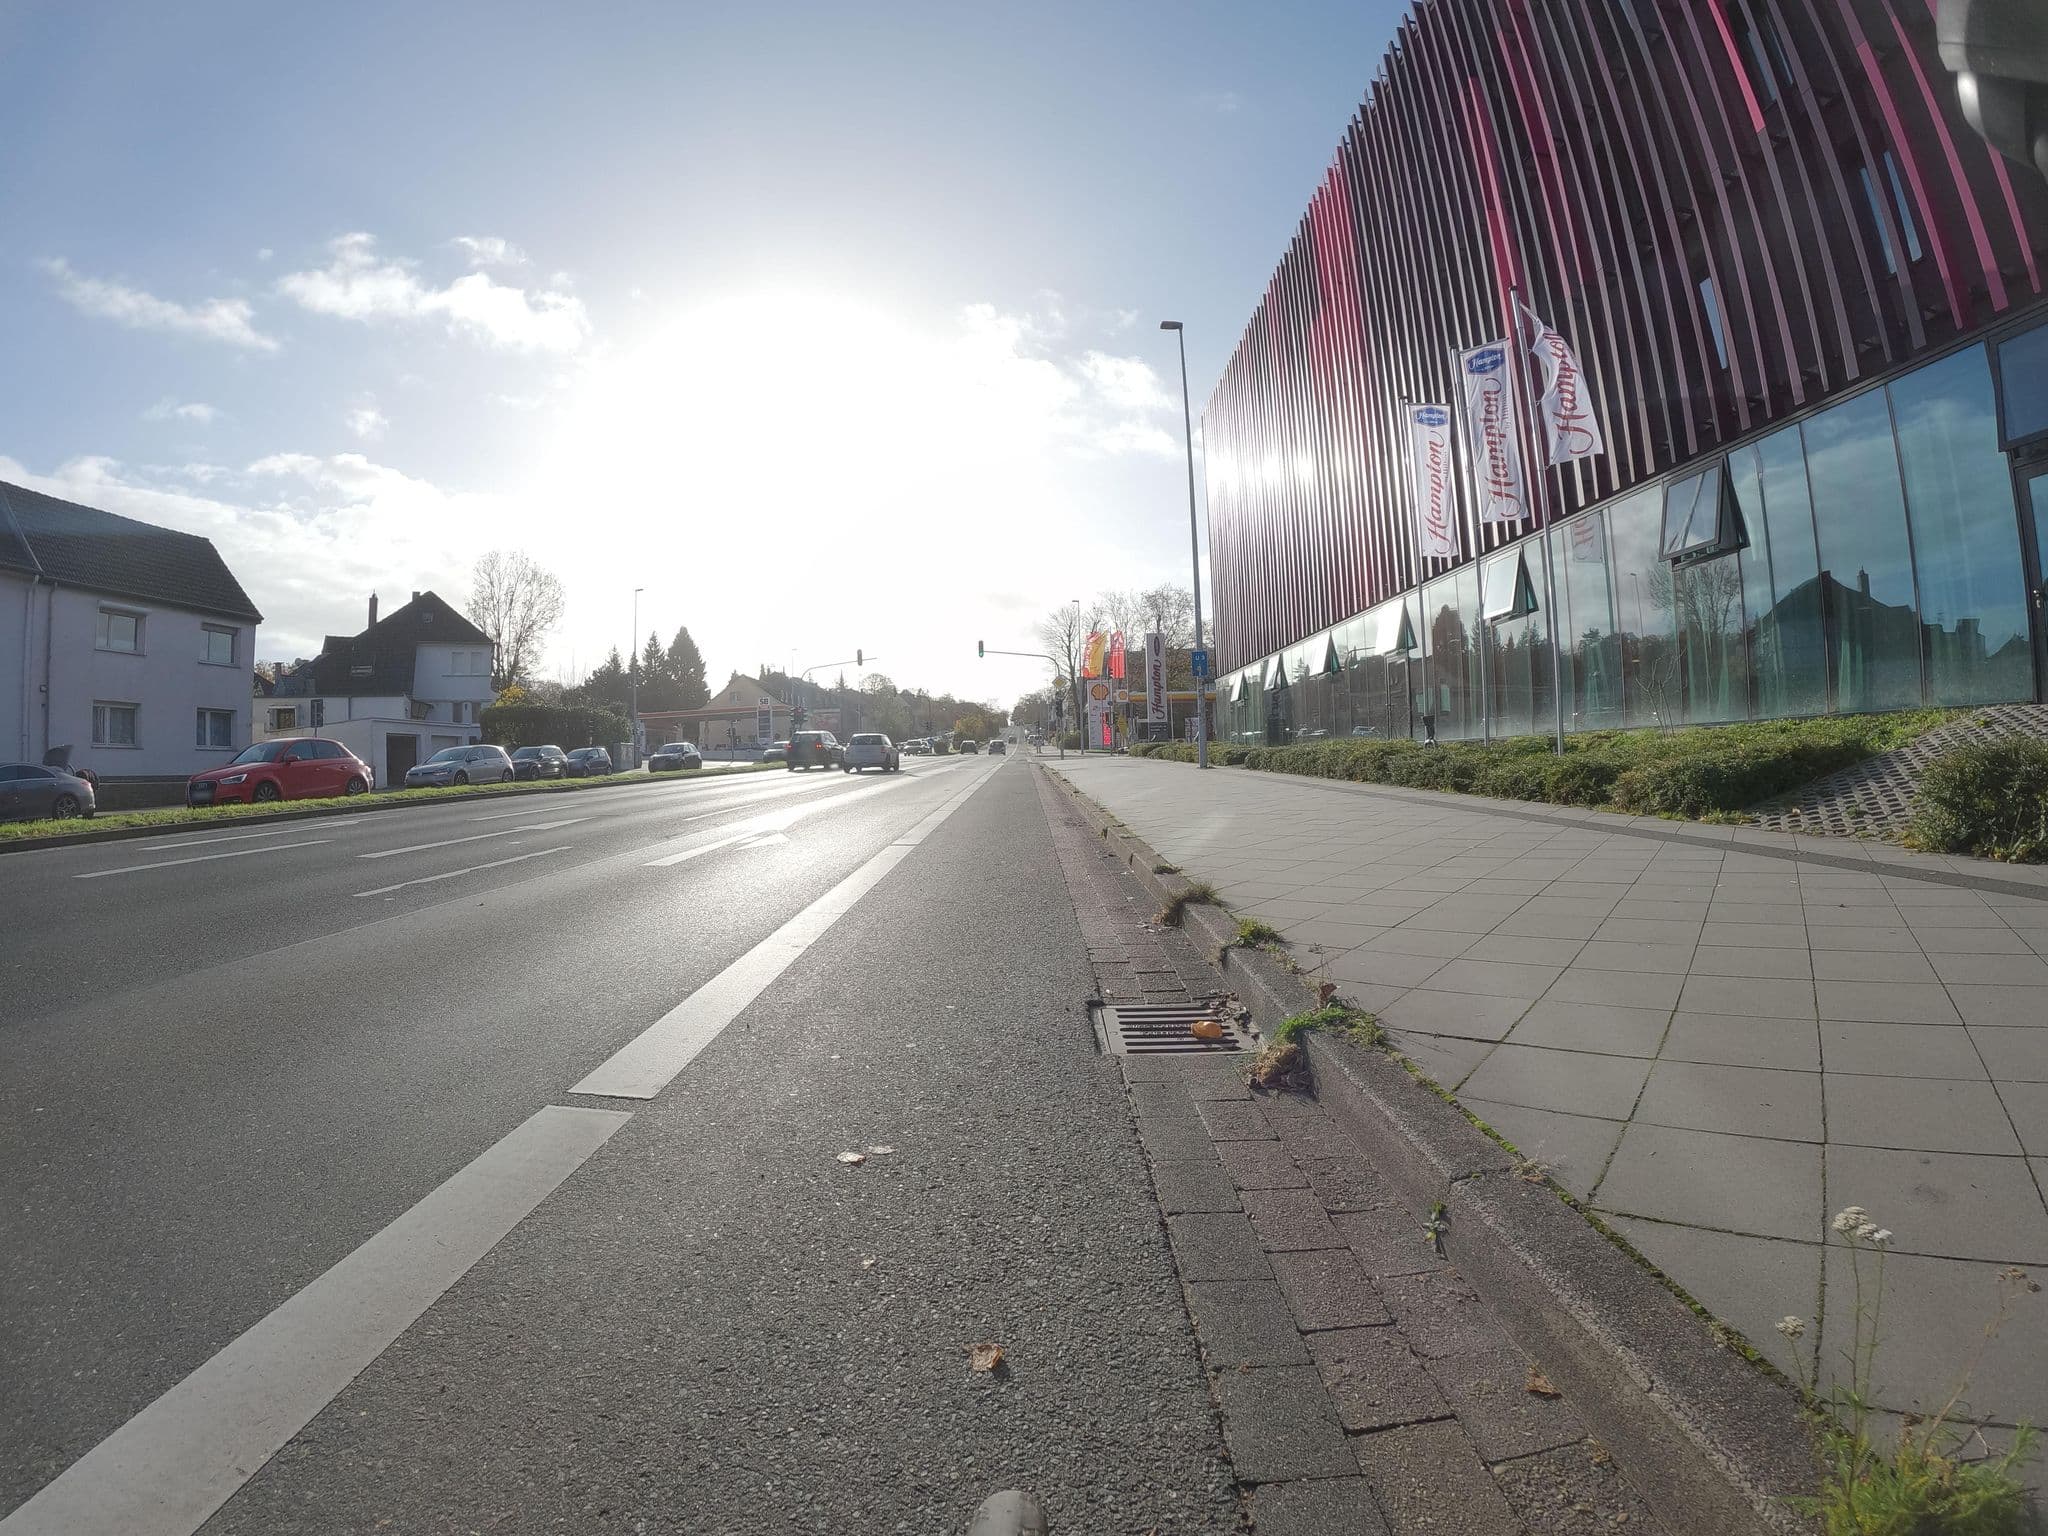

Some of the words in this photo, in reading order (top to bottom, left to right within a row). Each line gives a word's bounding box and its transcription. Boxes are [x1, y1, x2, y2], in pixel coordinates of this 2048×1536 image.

[1424, 430, 1450, 555] Hampton
[1479, 377, 1521, 518] Hampton
[1150, 659, 1166, 720] Hampton
